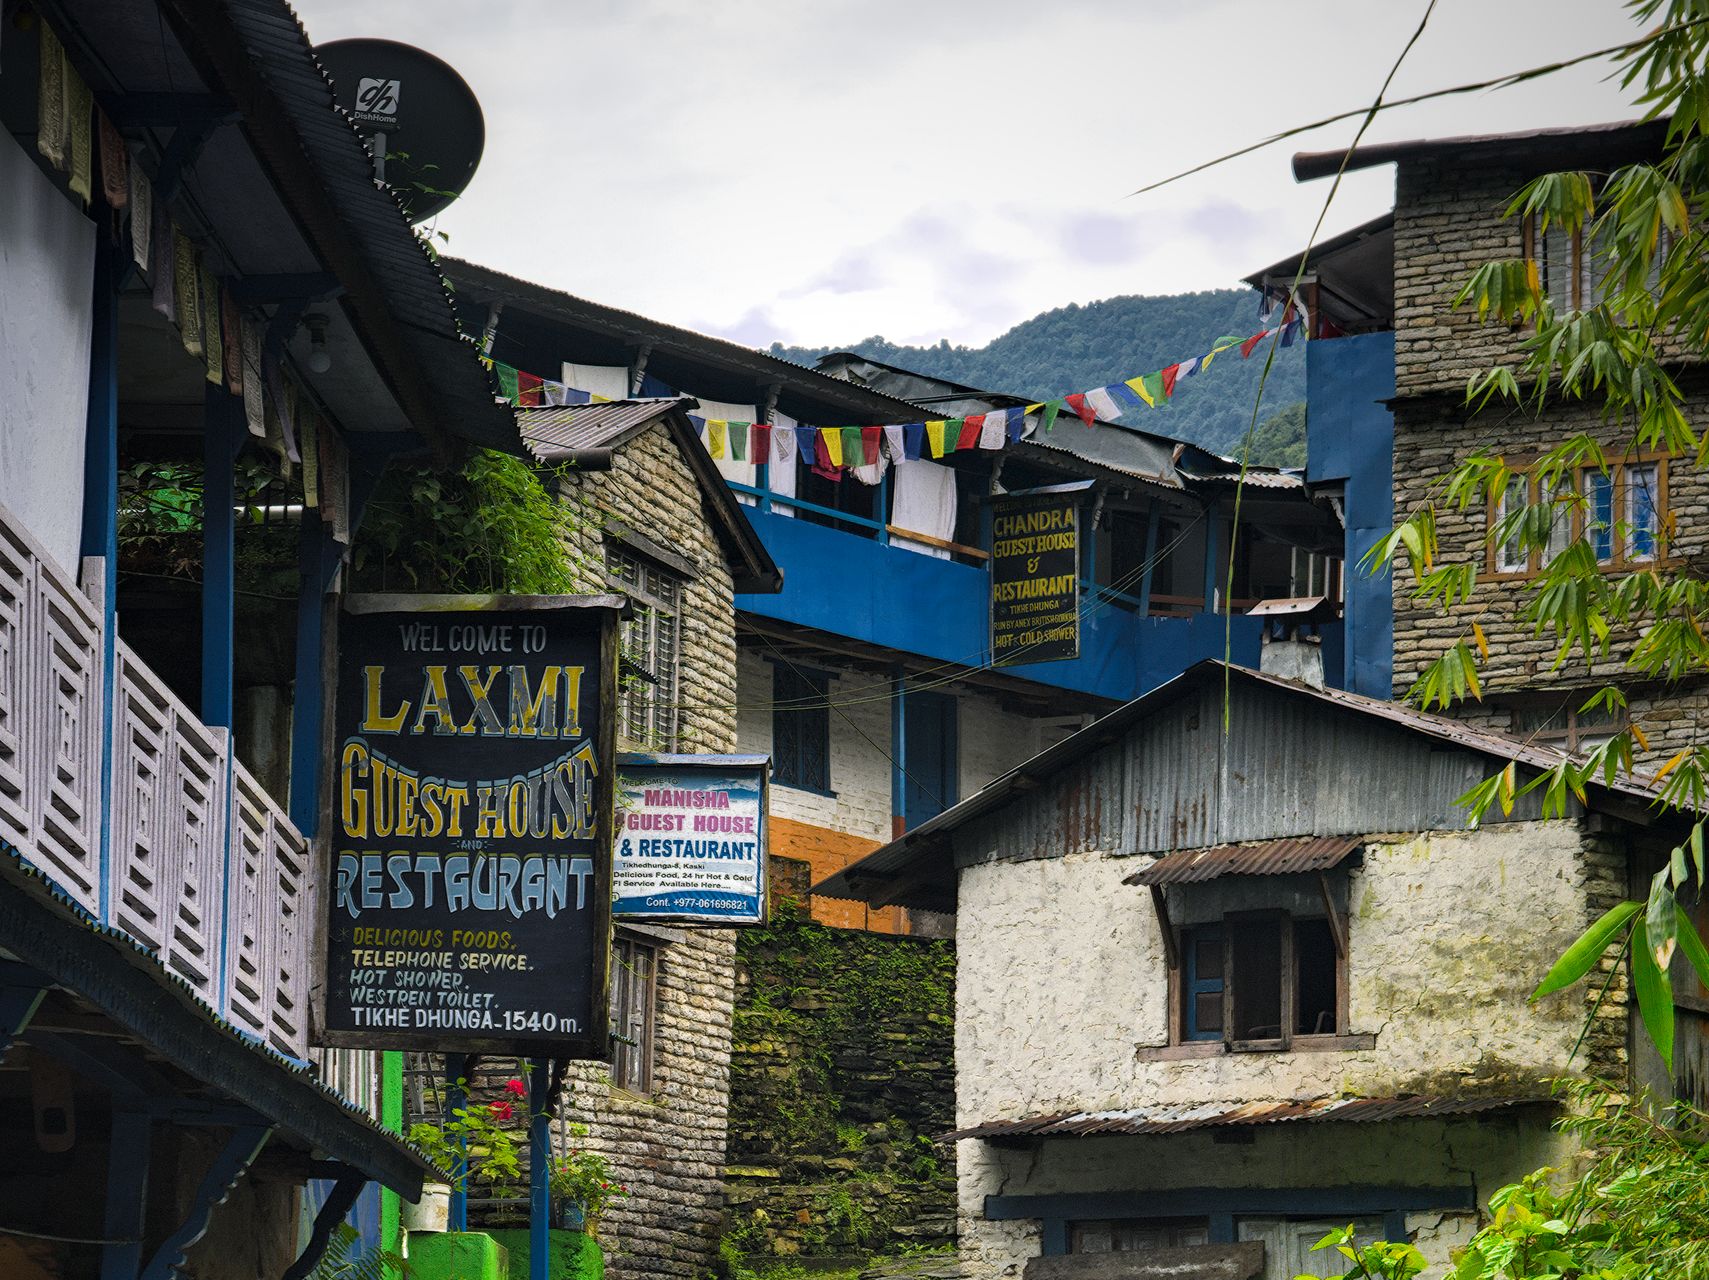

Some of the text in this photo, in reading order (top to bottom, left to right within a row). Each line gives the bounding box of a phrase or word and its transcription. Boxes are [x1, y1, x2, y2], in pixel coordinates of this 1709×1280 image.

[354, 111, 397, 123] DishHome
[993, 507, 1074, 537] CHANDRA
[1027, 556, 1041, 574] &
[993, 574, 1075, 602] RESTAURANT
[519, 625, 547, 653] TO
[995, 626, 1075, 648] HOT COLD SHOWER
[359, 665, 585, 739] LAXMI
[341, 736, 599, 840] GUEST HOUSE
[621, 778, 665, 786] WELCOME
[644, 789, 730, 809] MANISHA
[627, 813, 754, 834] GUEST HOUSE
[620, 838, 756, 860] & RESTAURANT
[336, 849, 594, 920] RESTAURANT
[659, 880, 699, 888] Available
[733, 874, 753, 883] Cold
[645, 897, 748, 911] Cont. +977-061696821
[353, 927, 517, 951] DELICIOUS FOODS.
[351, 949, 534, 974] TELEPHONE SERVICE.
[349, 968, 470, 991] HOT SHOWER.
[349, 986, 499, 1009] WESTREN TOILET.
[350, 1007, 410, 1028] TIKHE
